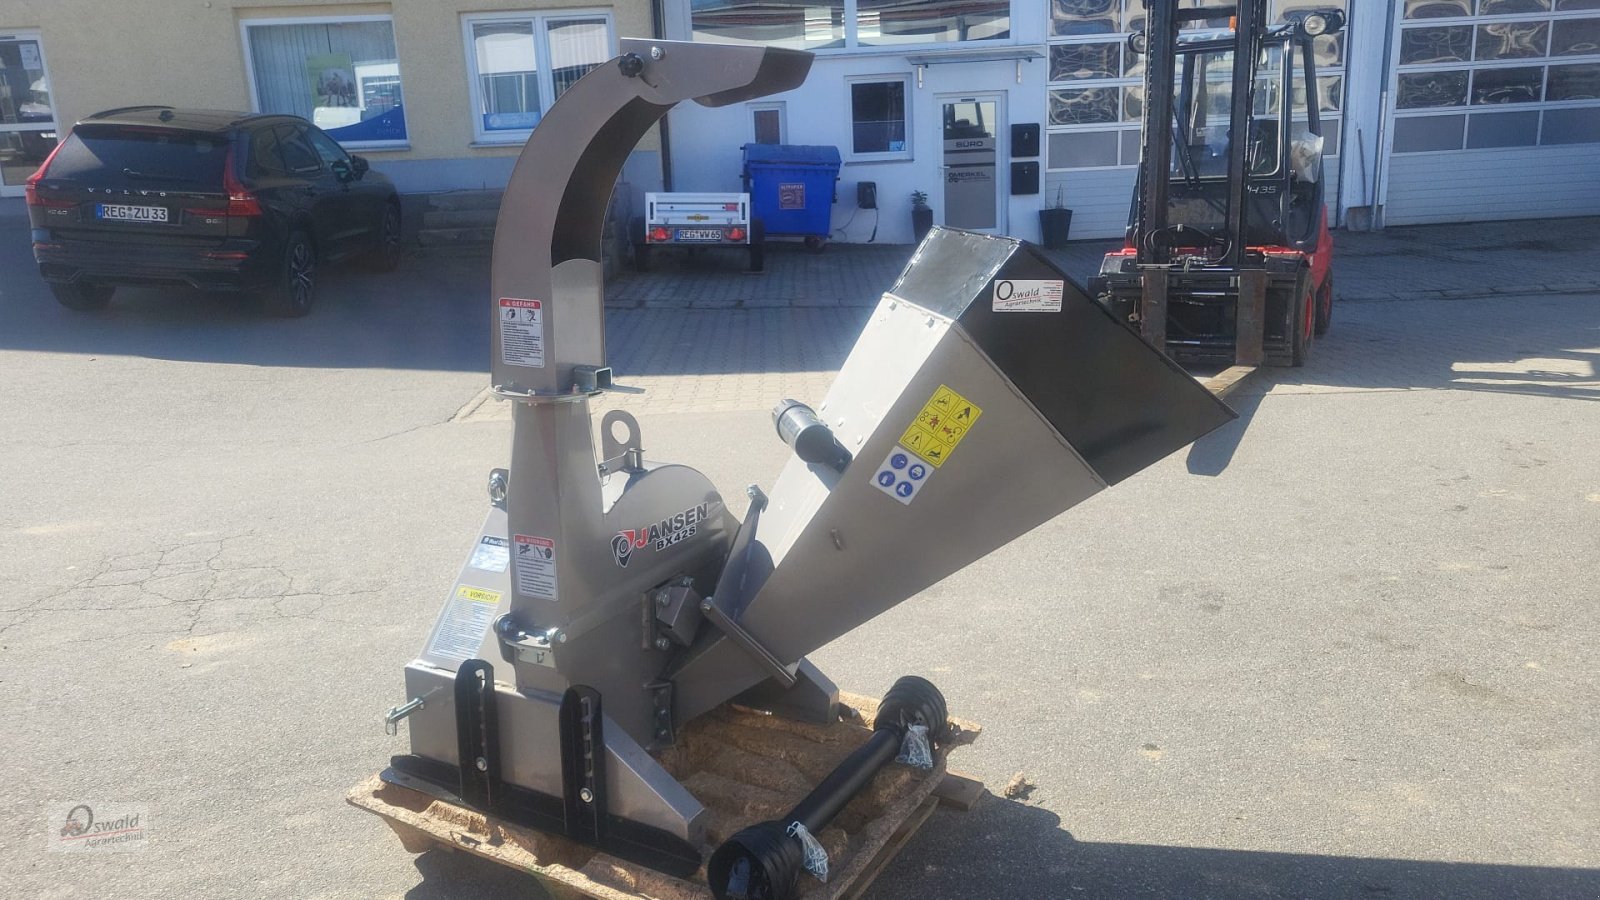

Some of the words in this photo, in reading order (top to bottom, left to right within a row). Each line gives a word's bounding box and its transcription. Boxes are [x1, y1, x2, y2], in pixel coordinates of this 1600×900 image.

[88, 187, 166, 197] VOLVO
[103, 205, 126, 218] REG
[134, 207, 149, 219] ZU
[151, 208, 166, 220] 33
[679, 229, 695, 239] REG
[711, 230, 721, 239] 65
[996, 281, 1040, 301] Oswald
[636, 502, 708, 548] JANSEN
[656, 526, 696, 551] BX42S
[470, 591, 498, 602] VORSICHT
